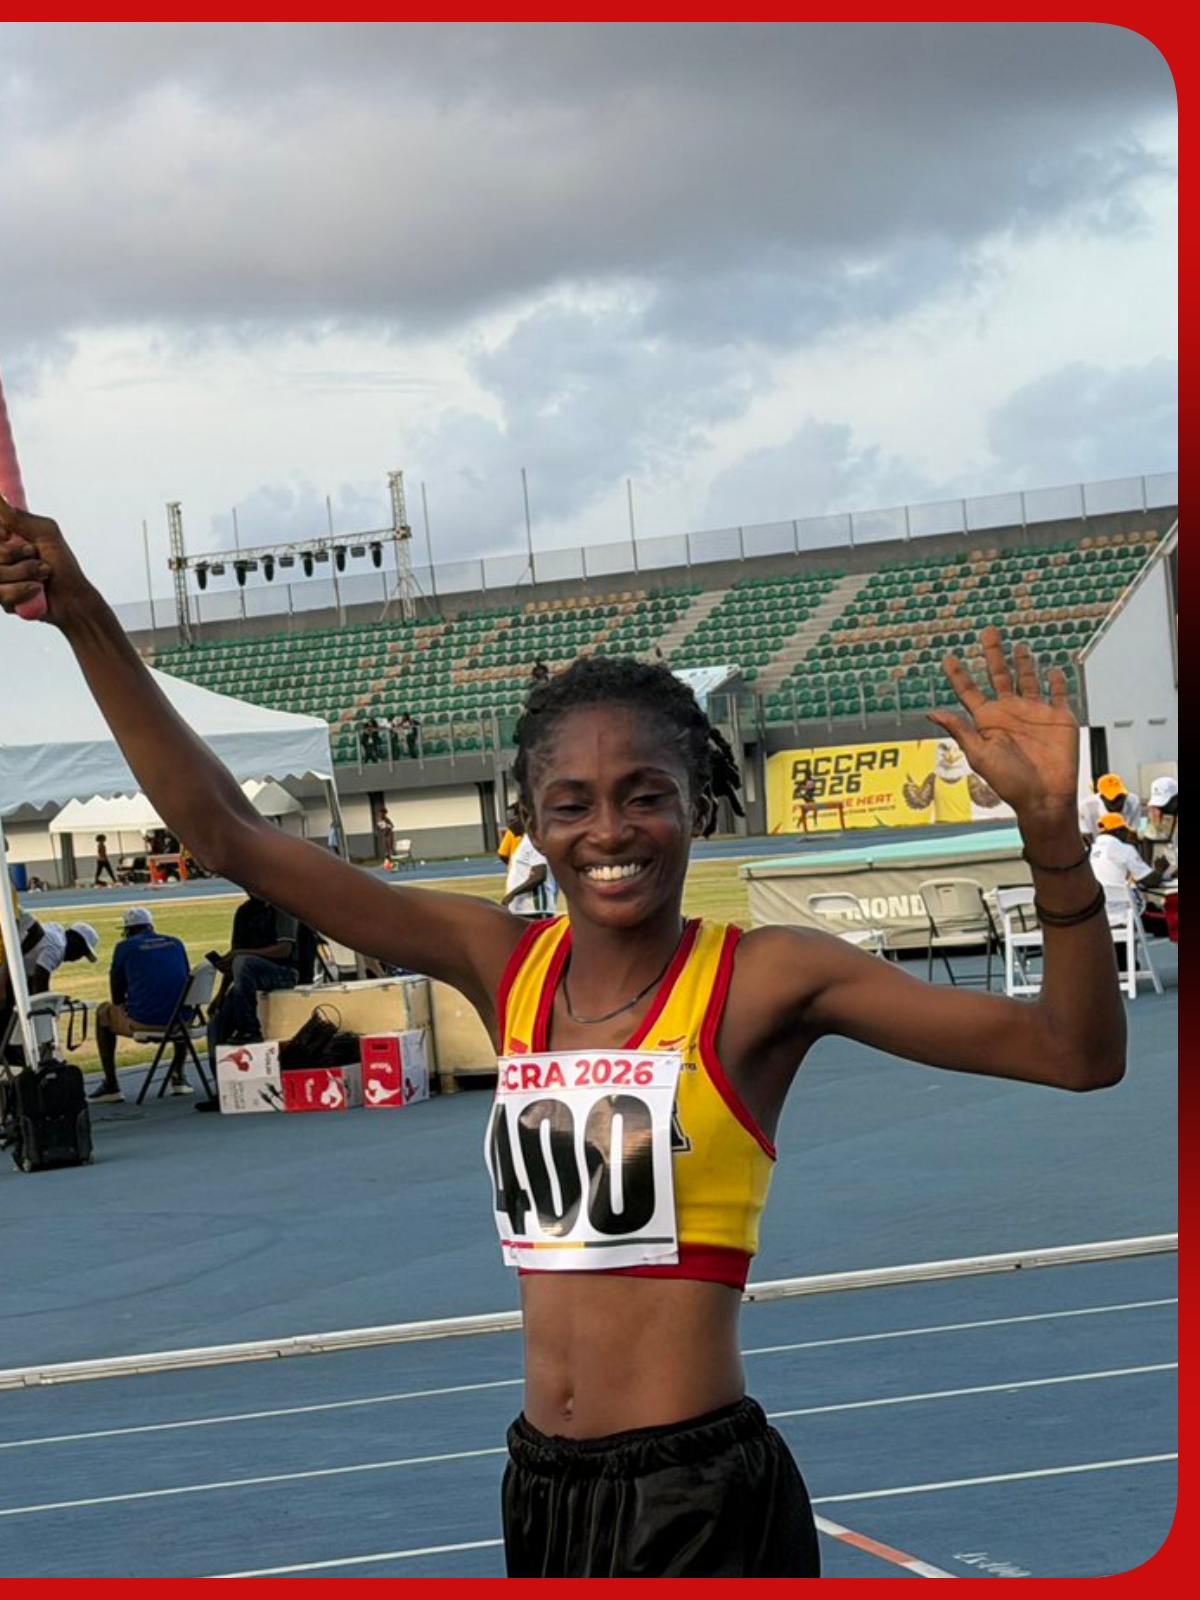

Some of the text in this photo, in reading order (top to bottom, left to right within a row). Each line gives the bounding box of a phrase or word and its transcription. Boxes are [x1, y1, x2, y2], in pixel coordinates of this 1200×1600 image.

[791, 748, 899, 780] ACCRA
[501, 1058, 655, 1091] CRA 2026
[490, 1094, 656, 1238] 400
